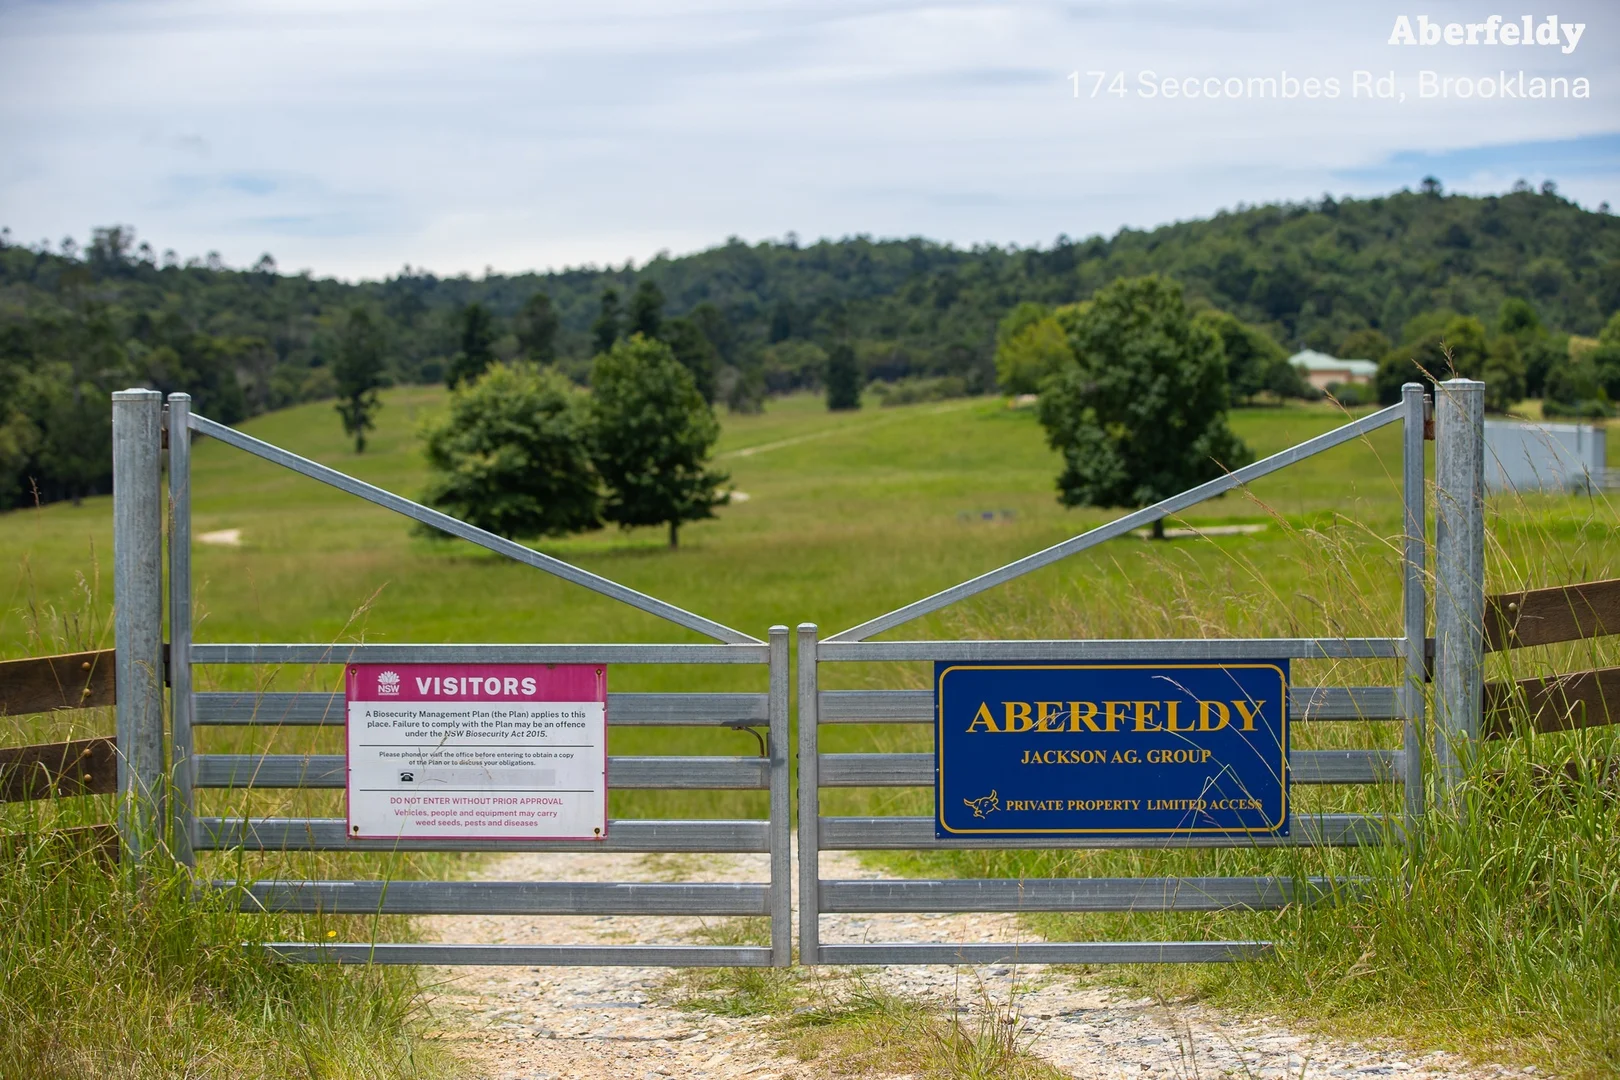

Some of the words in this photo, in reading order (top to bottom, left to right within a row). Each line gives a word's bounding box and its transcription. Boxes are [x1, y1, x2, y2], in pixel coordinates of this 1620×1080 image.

[378, 685, 400, 693] NSW
[416, 677, 536, 695] VISITORS
[419, 711, 470, 719] Management
[531, 711, 559, 719] applies
[965, 700, 1266, 732] ABERFELDY
[466, 730, 509, 738] Biosecurity
[1021, 750, 1107, 764] JACKSON
[1111, 750, 1142, 764] AG.
[1147, 750, 1212, 764] GROUP
[1006, 800, 1063, 811] PRIVATE
[1067, 800, 1141, 810] PROPERTY
[1147, 800, 1206, 810] LIMITED
[1209, 799, 1263, 810] ACCESS
[394, 809, 429, 817] Vehicles,
[431, 810, 457, 818] people
[476, 810, 517, 818] equipment
